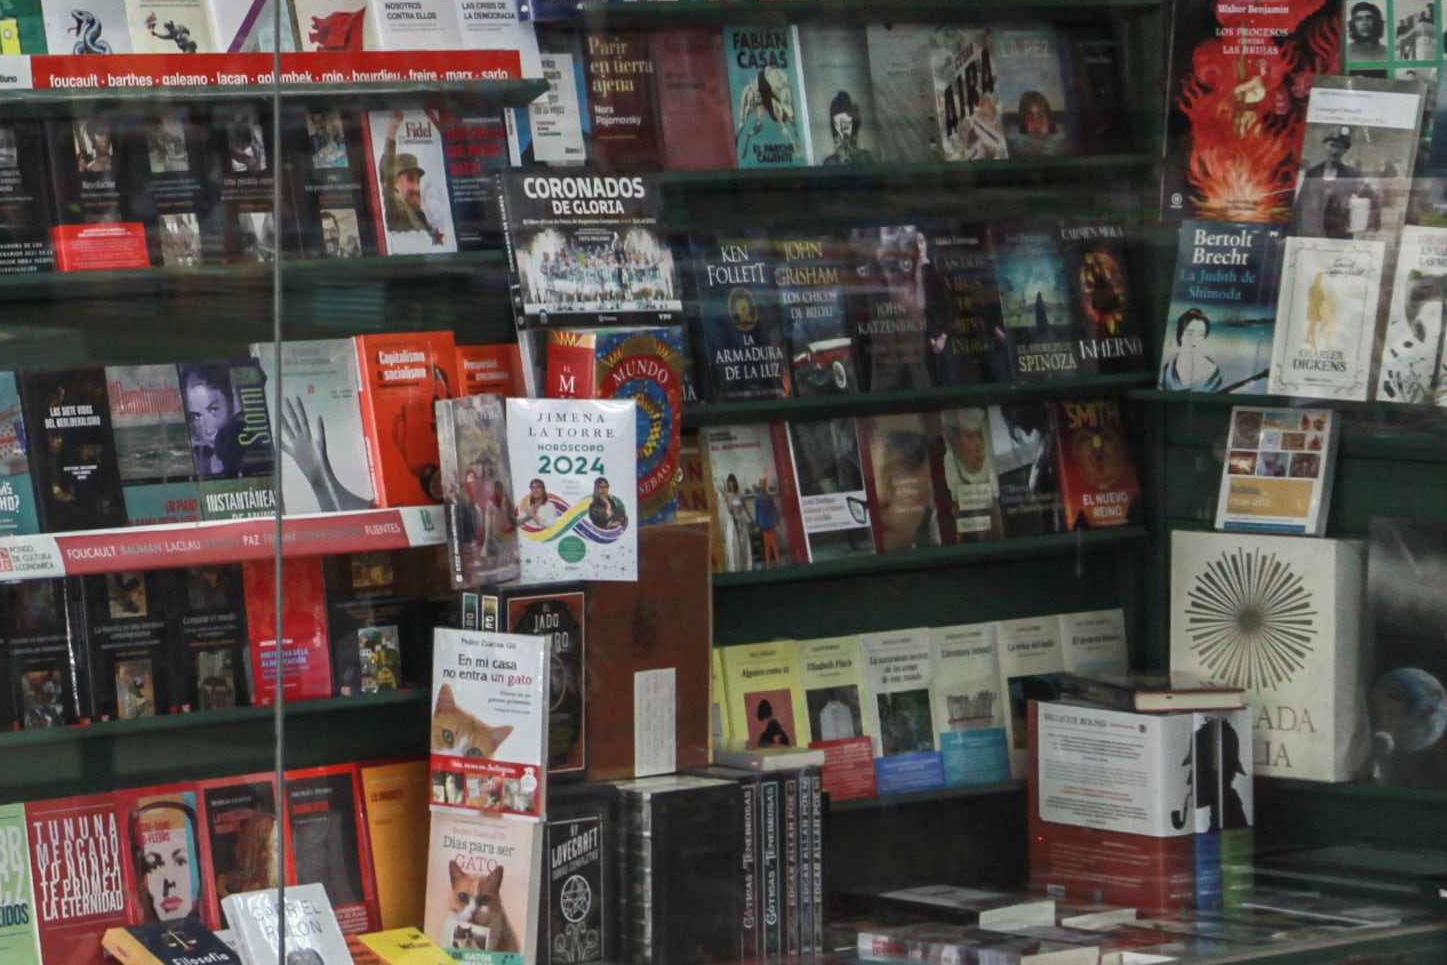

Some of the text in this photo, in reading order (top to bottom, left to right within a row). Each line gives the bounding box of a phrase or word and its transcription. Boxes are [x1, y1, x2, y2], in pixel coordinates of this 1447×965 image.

[524, 178, 645, 199] CORONADOS
[552, 201, 624, 214] DE GLORIA
[1194, 230, 1252, 248] Bertolt
[1192, 248, 1248, 266] Brecht
[707, 263, 765, 286] FOLLETT
[1018, 353, 1078, 372] SPINOZA
[613, 361, 669, 386] MUNDO
[537, 412, 605, 423] JIMENA
[529, 427, 614, 437] LA TORRE
[538, 443, 605, 452] HORÓSCOPO
[538, 456, 605, 474] 2024
